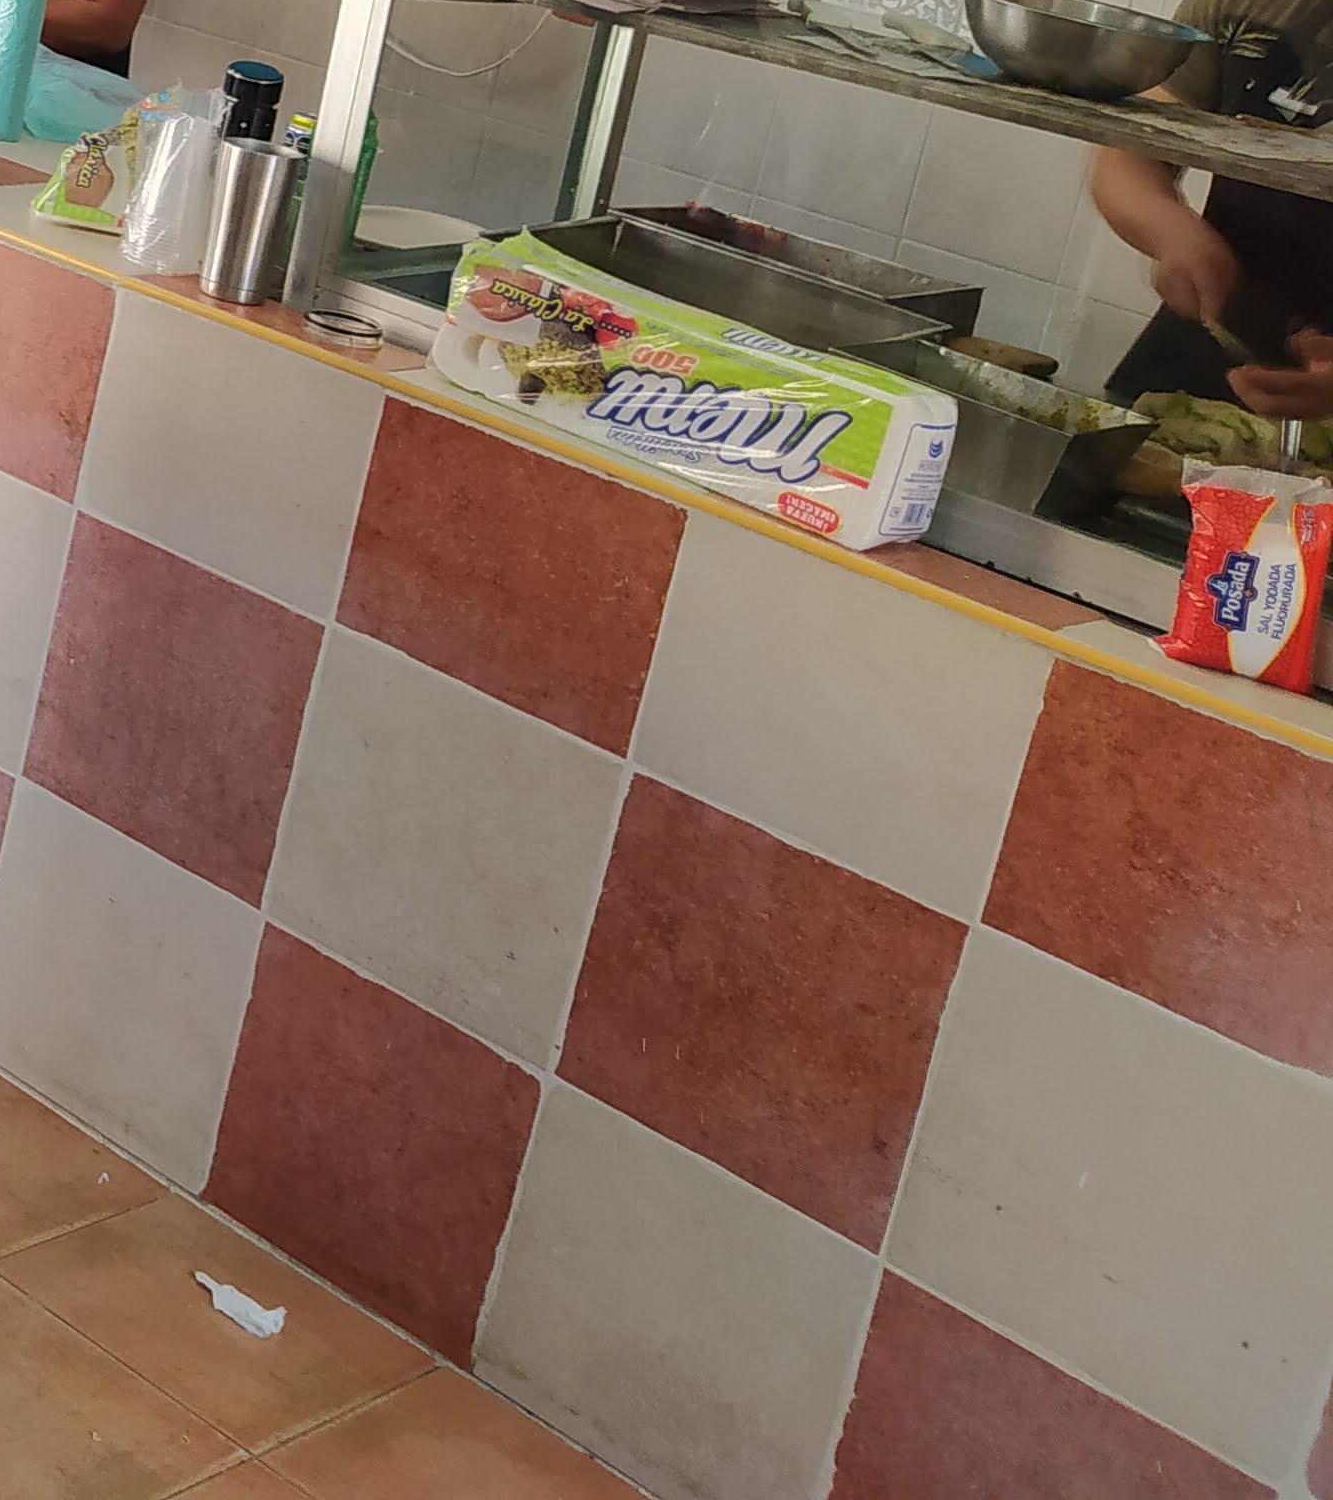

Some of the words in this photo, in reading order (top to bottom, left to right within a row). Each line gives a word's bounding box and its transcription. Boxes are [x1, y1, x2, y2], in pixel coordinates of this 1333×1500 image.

[564, 308, 594, 332] La
[630, 345, 699, 376] 500
[1221, 561, 1251, 622] Posada
[1258, 608, 1273, 635] SAL
